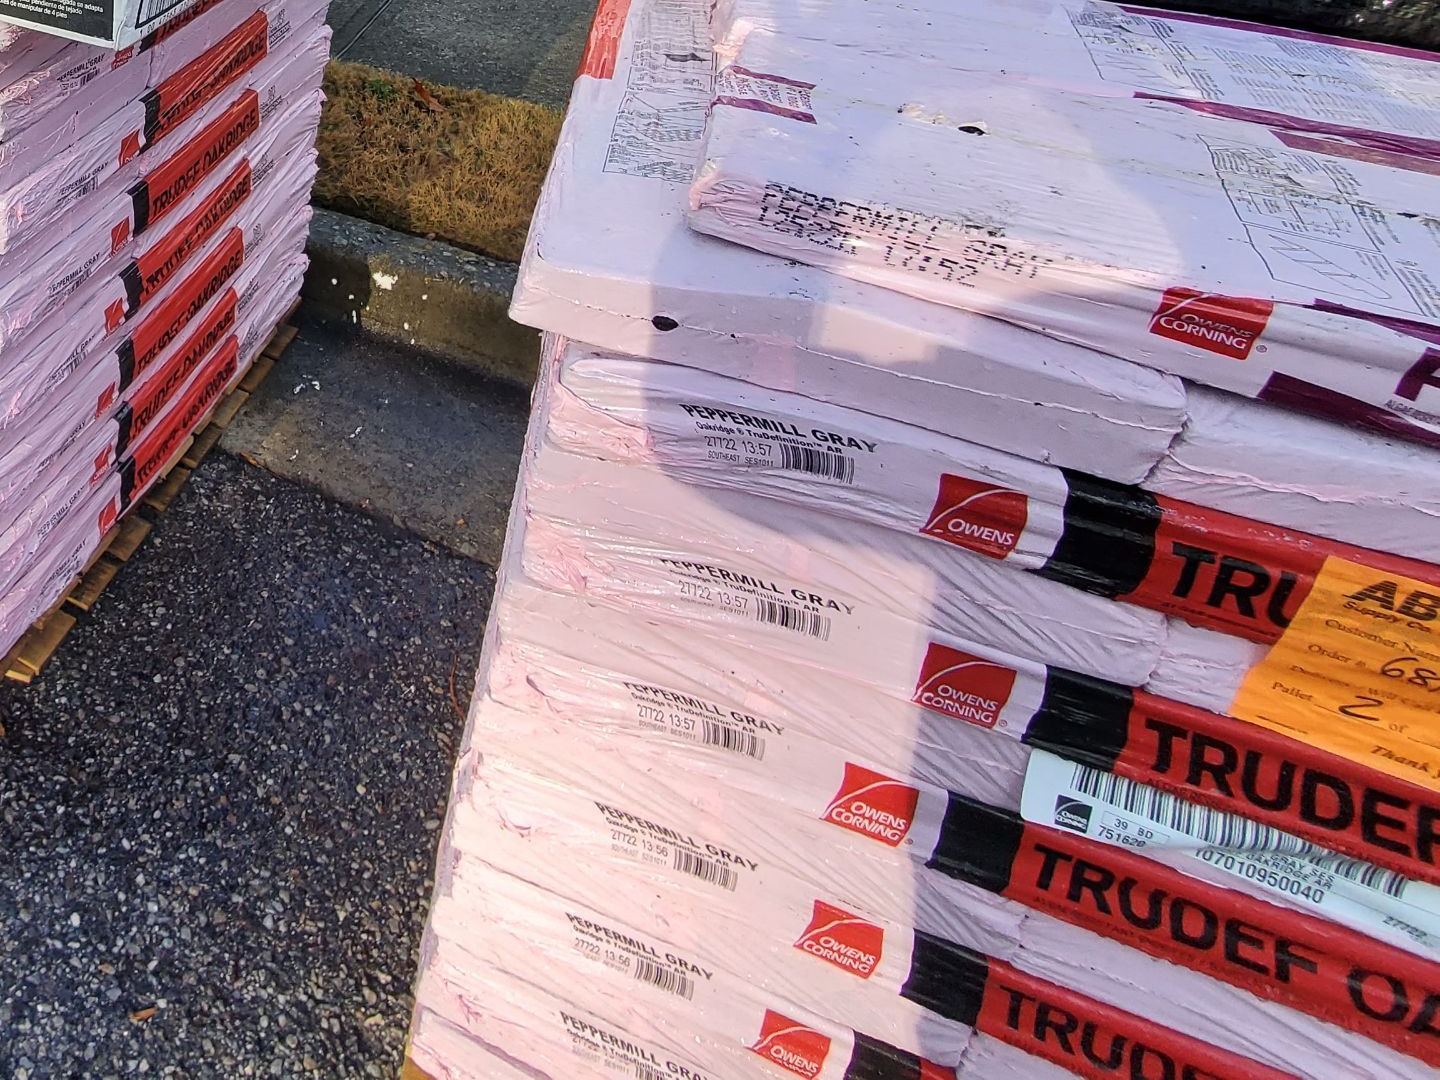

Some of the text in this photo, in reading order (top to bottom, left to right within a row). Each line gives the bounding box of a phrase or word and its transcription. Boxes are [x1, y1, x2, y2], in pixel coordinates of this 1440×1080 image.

[1159, 316, 1250, 351] CORNING
[1180, 313, 1257, 340] OWENS
[678, 403, 879, 454] PEPPERMILL GRAY
[696, 421, 735, 435] Oakridge
[826, 445, 844, 455] AR
[704, 435, 773, 457] 27722 13:57
[947, 518, 1015, 547] OWENS
[659, 557, 857, 616] PEPPERMILL GRAY
[678, 580, 749, 609] 27722 13:57
[1171, 542, 1298, 629] TRU
[803, 604, 820, 614] AR
[1343, 600, 1398, 624] Supply
[1325, 619, 1399, 649] Customer
[1308, 643, 1352, 665] Order
[936, 684, 999, 712] OWENS
[1272, 681, 1314, 701] Pallet
[622, 681, 786, 736] PEPPERMILL GRAY
[636, 704, 696, 732] 27722 13:57
[920, 691, 994, 724] CORNING
[1338, 695, 1384, 722] 2
[1388, 722, 1407, 734] of
[1371, 745, 1430, 773] Thank
[830, 807, 902, 841] CORNING
[850, 800, 907, 831] OWENS
[1114, 818, 1154, 839] 39 BD
[594, 800, 760, 872] PEPPERMILL GRAY
[610, 828, 638, 847] 27722
[1245, 853, 1311, 882] OAKRIDGE
[1269, 853, 1336, 883] GRAY SES
[1033, 841, 1319, 985] TRUDEF
[565, 911, 714, 981] PEPPERMILL GRAY
[802, 939, 871, 974] CORNING
[819, 936, 876, 965] OWENS
[560, 1010, 662, 1067] PEPPERMILL
[1000, 984, 1218, 1080] TRUD
[769, 1045, 820, 1073] OWENS
